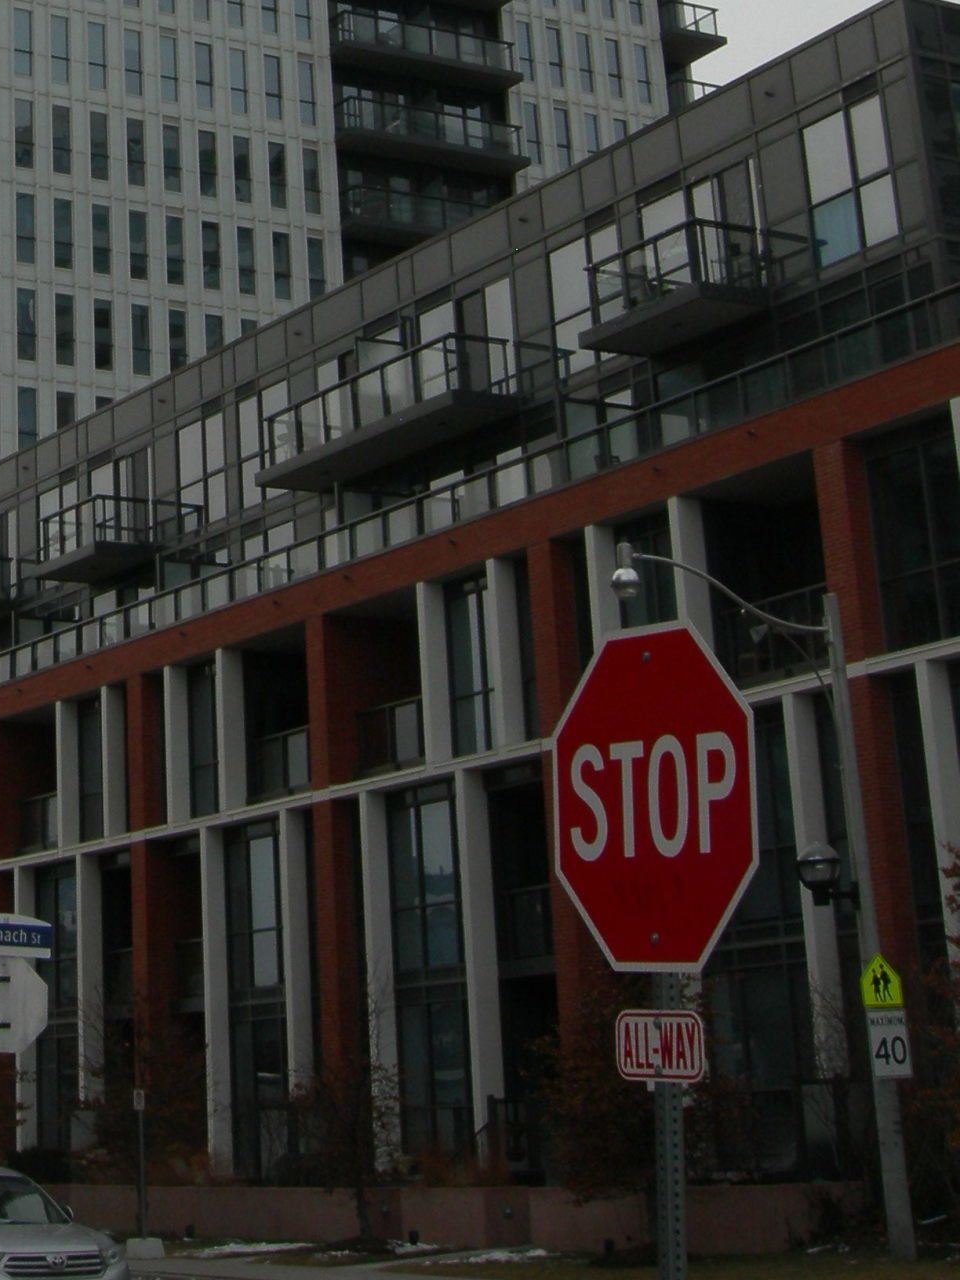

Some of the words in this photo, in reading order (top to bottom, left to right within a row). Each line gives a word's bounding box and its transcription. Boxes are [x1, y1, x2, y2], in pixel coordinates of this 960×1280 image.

[569, 731, 737, 862] STOP
[623, 1022, 696, 1070] ALL-WAY
[875, 1036, 907, 1065] 40
